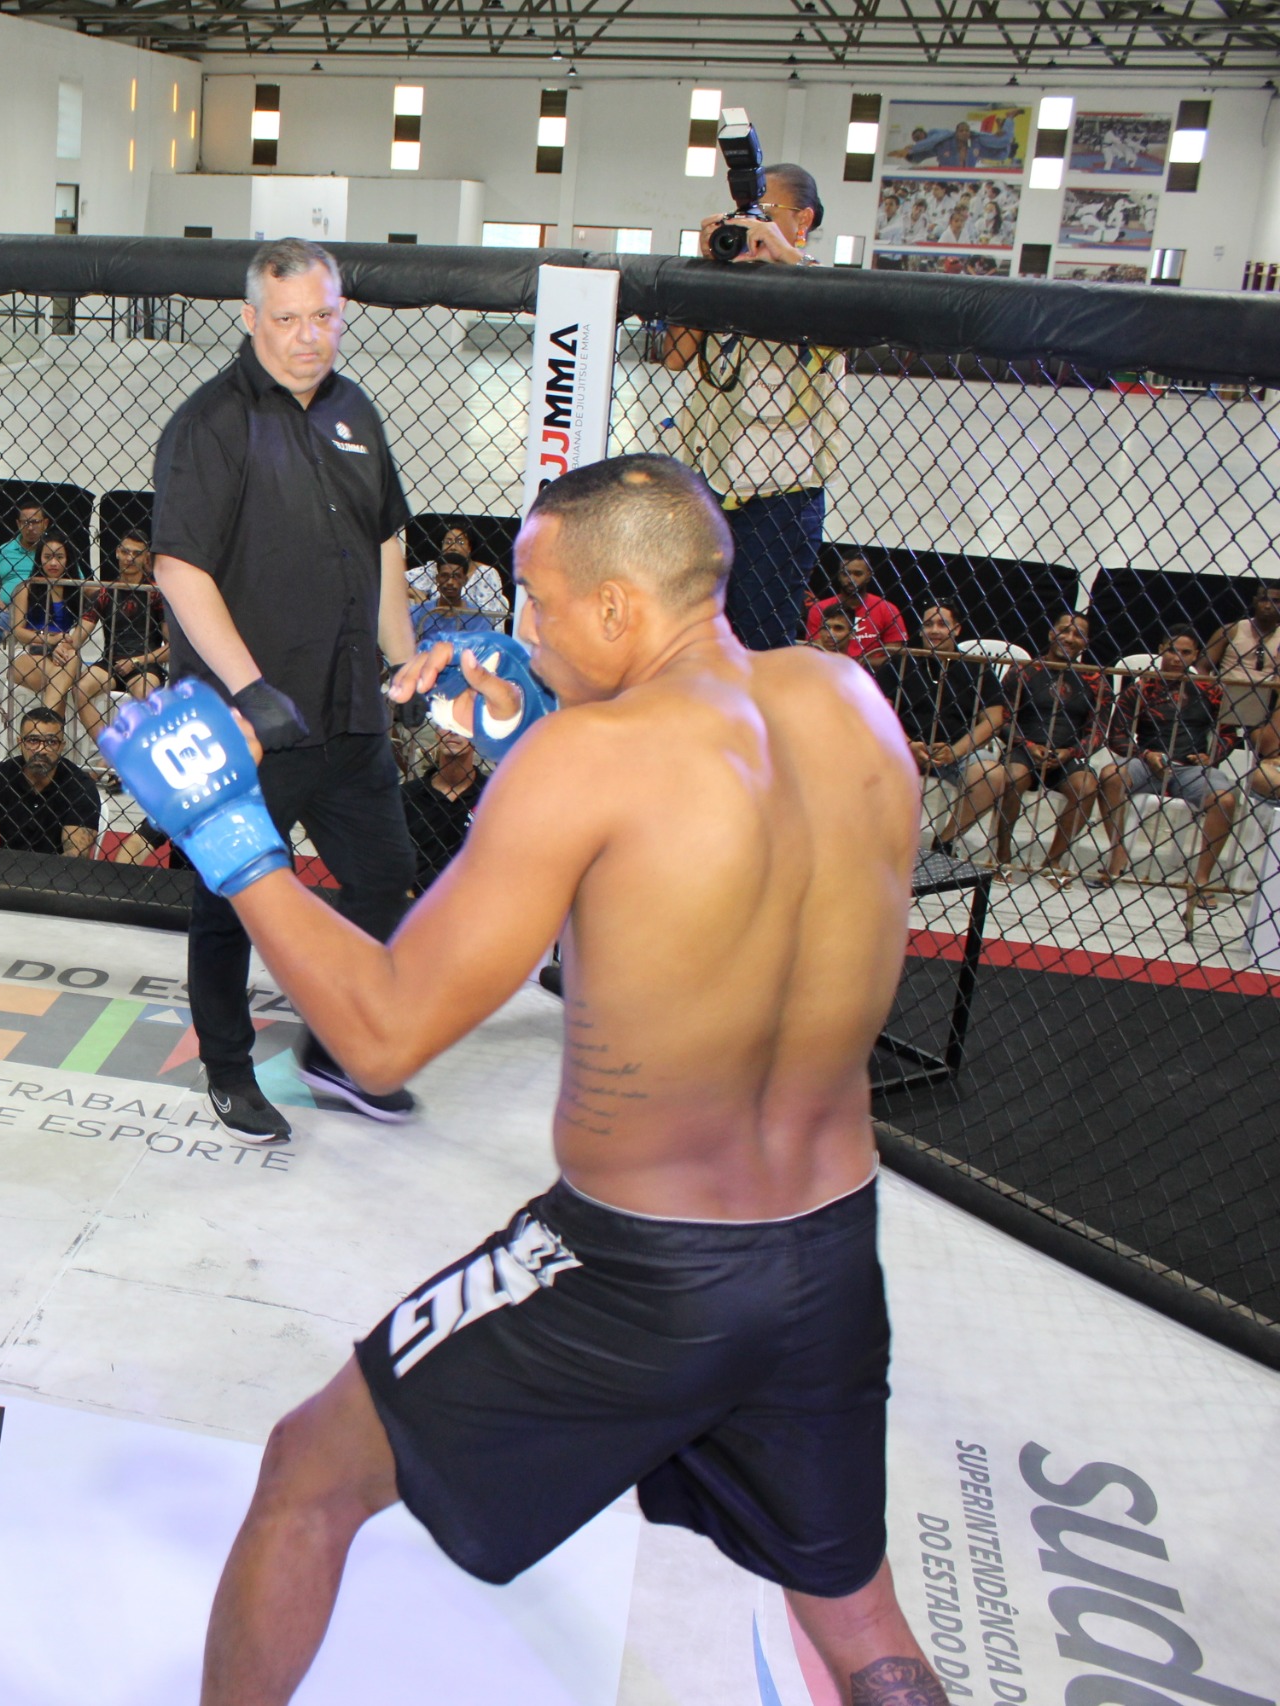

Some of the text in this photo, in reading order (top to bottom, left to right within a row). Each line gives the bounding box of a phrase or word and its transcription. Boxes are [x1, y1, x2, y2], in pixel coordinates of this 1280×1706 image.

[581, 323, 591, 350] MMA
[578, 363, 587, 392] JITSU
[575, 413, 584, 427] DE
[576, 394, 585, 410] JIU
[151, 720, 227, 790] QC
[2, 959, 109, 989] DO
[38, 1114, 296, 1172] ESPORTE
[955, 1439, 1023, 1676] SUPERINTENDÊNCIA
[1019, 1440, 1277, 1706] sud
[917, 1512, 974, 1698] DO ESTADO DA
